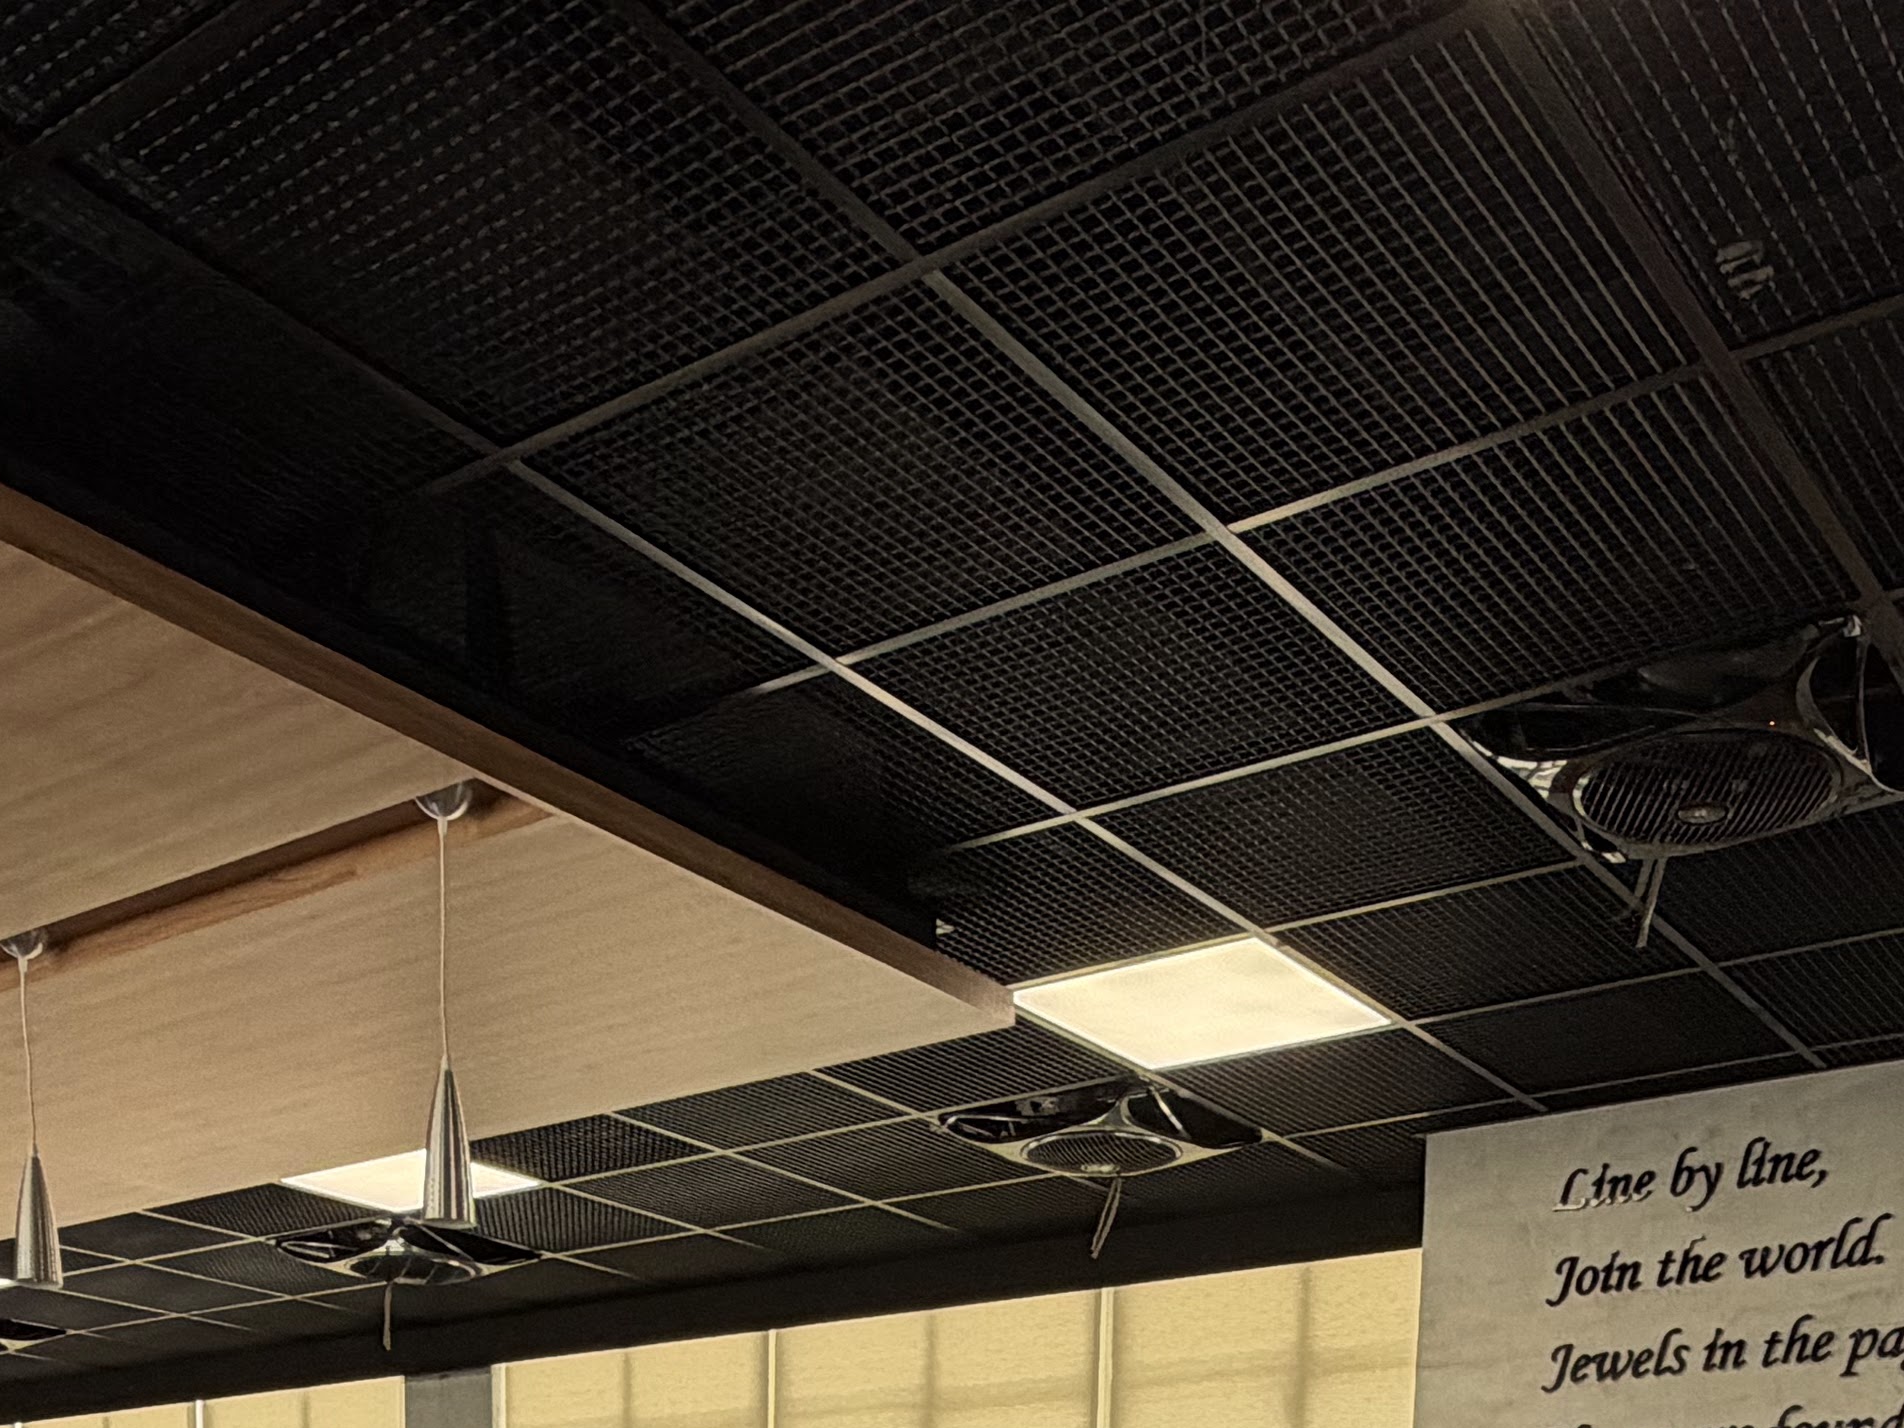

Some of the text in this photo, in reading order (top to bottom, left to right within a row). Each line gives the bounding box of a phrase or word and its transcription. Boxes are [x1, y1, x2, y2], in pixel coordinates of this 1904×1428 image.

[1552, 1136, 1829, 1212] Line by line,
[1546, 1212, 1894, 1307] Join the world.
[1541, 1328, 1691, 1393] Jewels
[1702, 1327, 1746, 1374] in
[1762, 1313, 1836, 1370] the
